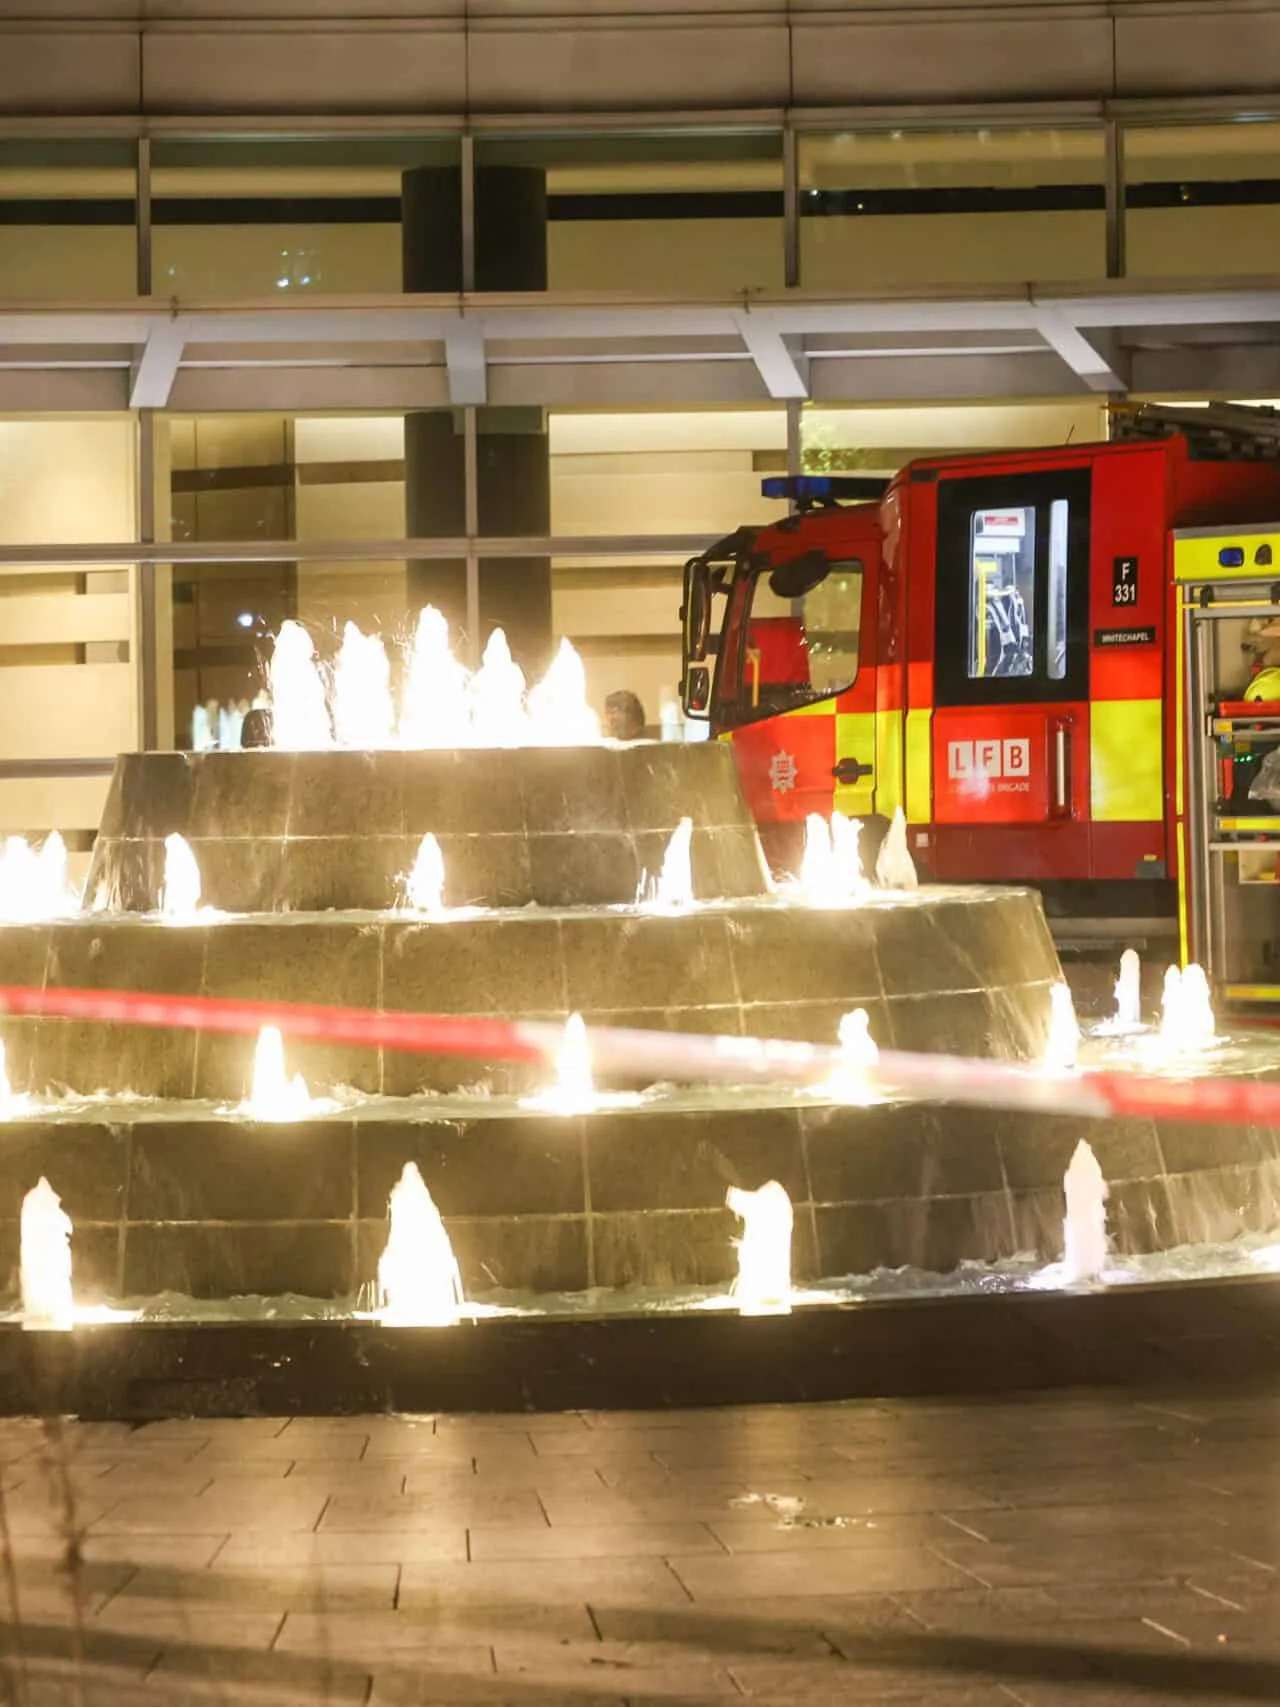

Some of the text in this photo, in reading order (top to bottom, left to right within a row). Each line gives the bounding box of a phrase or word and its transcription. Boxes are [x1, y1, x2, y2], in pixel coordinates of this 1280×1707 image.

[1122, 562, 1130, 580] F
[1115, 584, 1135, 602] 331
[1102, 632, 1149, 642] WHITECHAPEL
